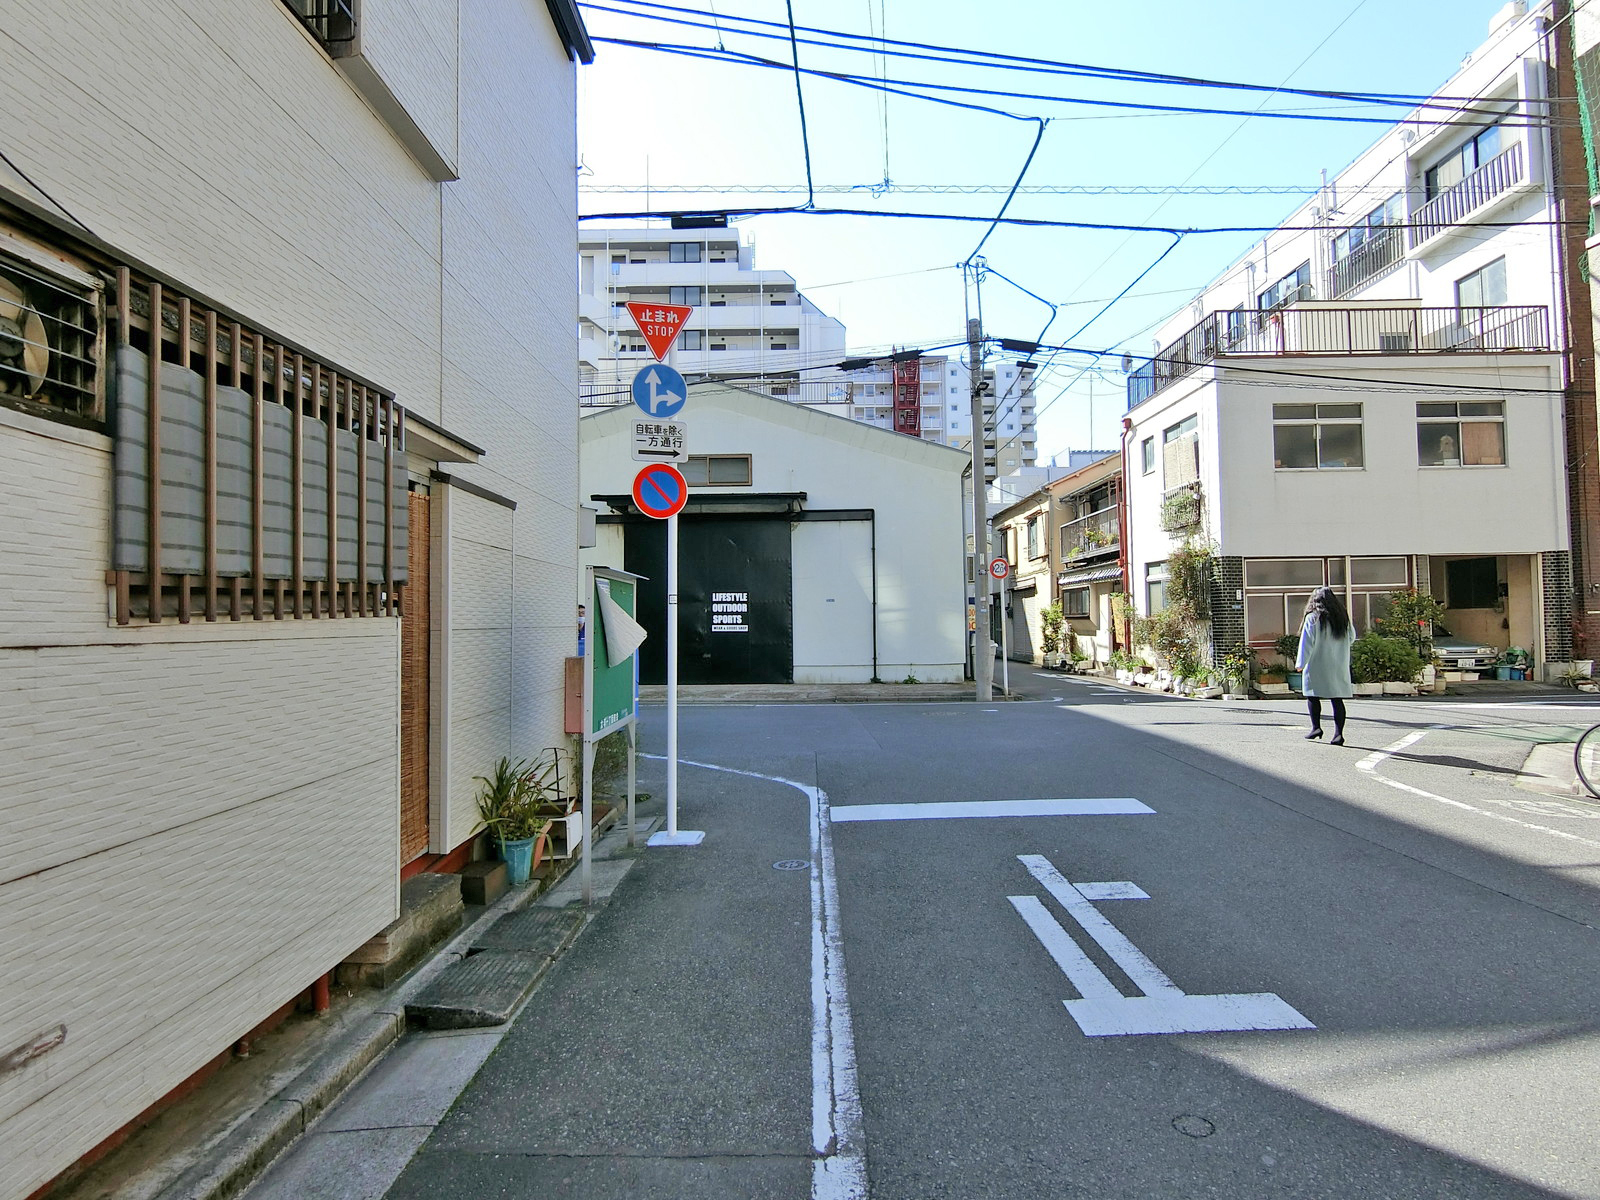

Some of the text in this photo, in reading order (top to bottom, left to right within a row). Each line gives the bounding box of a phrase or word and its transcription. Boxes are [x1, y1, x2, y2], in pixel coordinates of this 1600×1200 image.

[640, 309, 679, 323] 止まれ
[647, 325, 674, 337] STOP
[636, 424, 683, 436] 自転車を除く
[636, 436, 683, 448] 一方通行
[712, 593, 748, 602] LIFESTYLE
[712, 603, 748, 612] OUTDOOR
[713, 615, 742, 624] SPORTS
[1006, 854, 1317, 1036] 止
